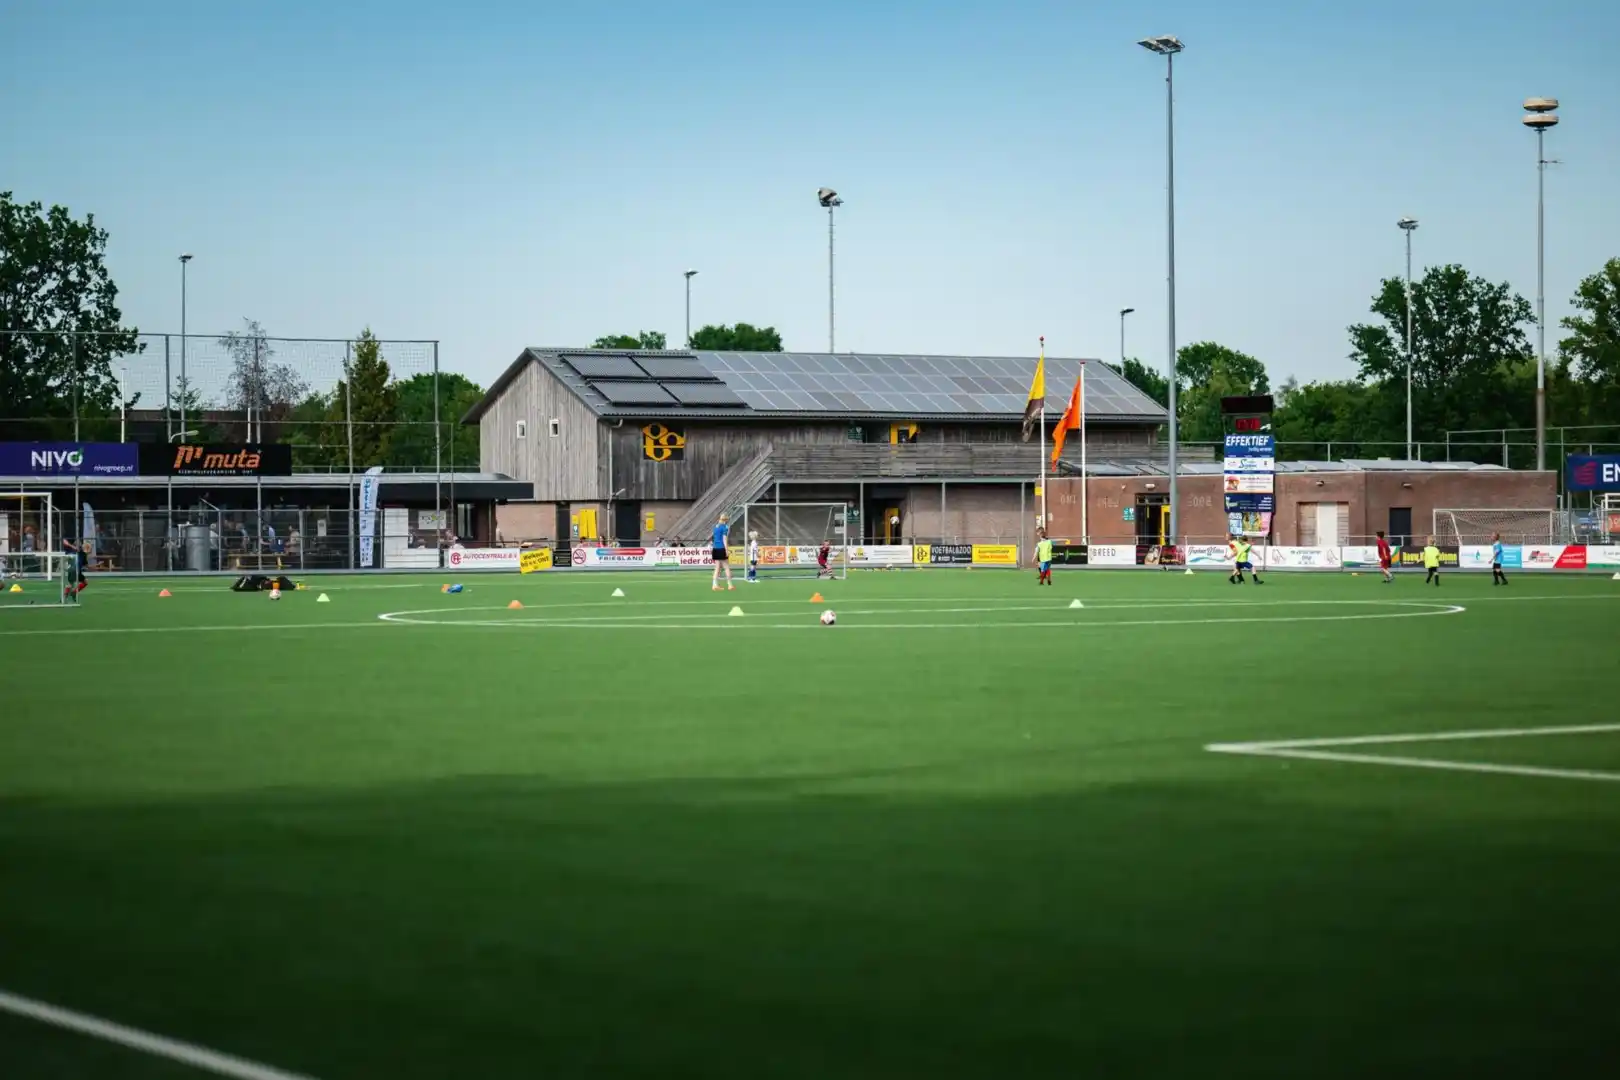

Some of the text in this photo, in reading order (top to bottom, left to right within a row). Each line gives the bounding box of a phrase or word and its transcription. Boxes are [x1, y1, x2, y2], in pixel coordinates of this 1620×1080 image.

[1225, 435, 1270, 447] EFFEKTIEF
[31, 450, 83, 467] NIVO
[203, 449, 261, 468] muta
[678, 548, 701, 556] vloek
[680, 557, 701, 565] ieder
